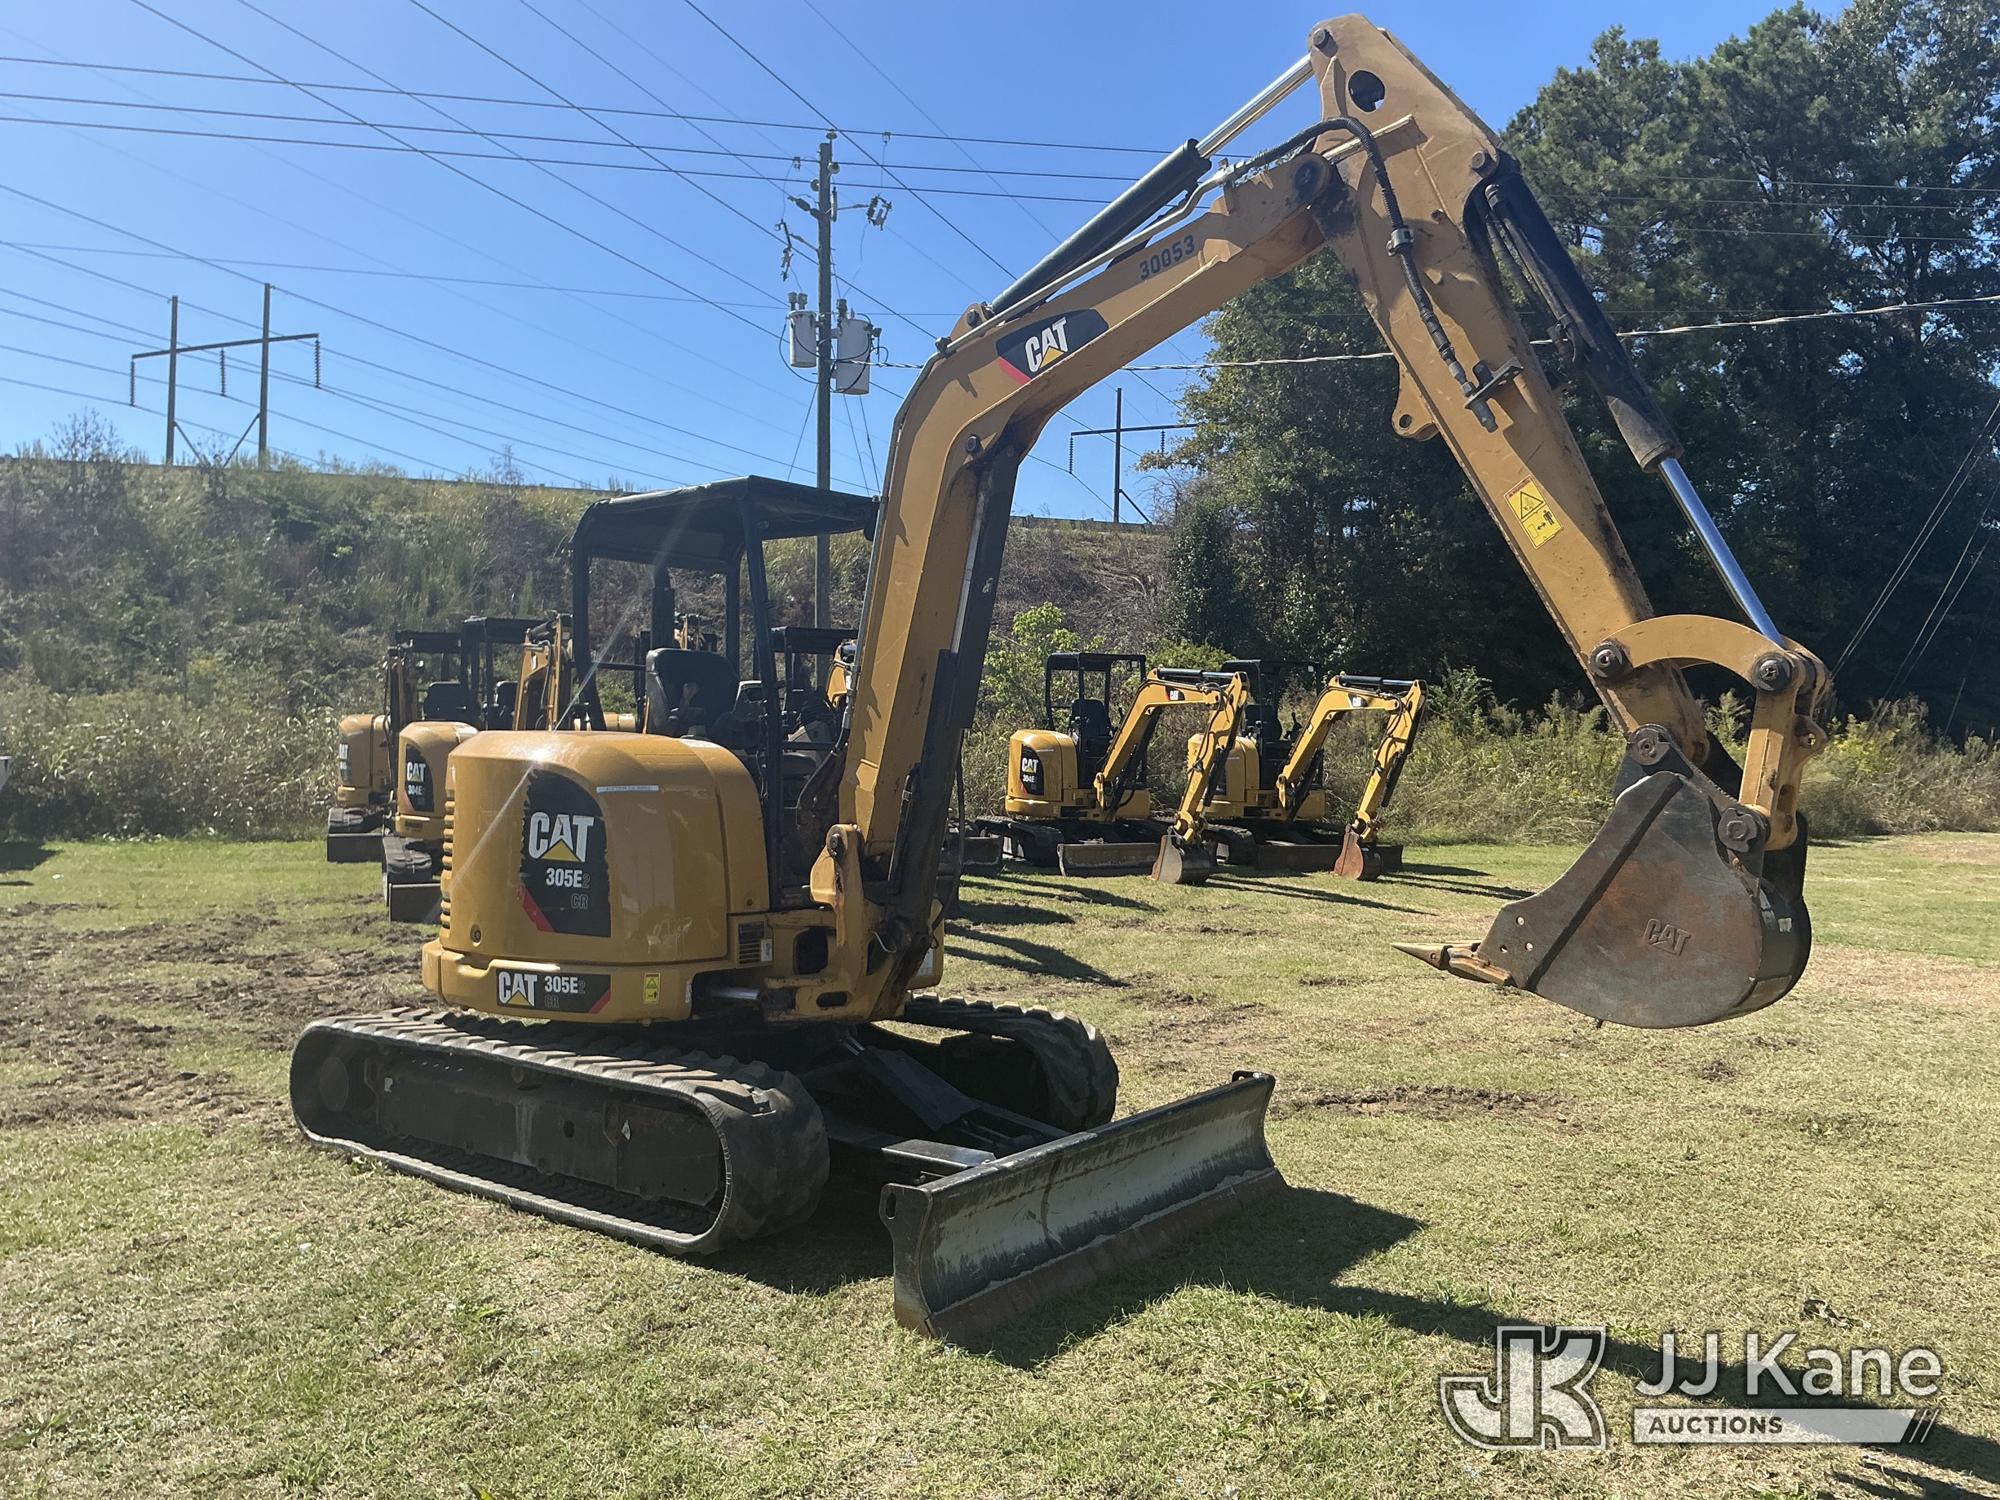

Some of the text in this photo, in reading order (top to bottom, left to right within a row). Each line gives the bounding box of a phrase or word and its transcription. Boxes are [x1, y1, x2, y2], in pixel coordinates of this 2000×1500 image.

[1138, 234, 1195, 280] 30053
[1024, 316, 1069, 373] CAT
[406, 761, 426, 783] CAT
[1021, 757, 1039, 773] CAT
[528, 811, 595, 862] CAT
[570, 893, 589, 910] CR
[1644, 918, 1692, 957] CAT
[498, 971, 538, 1007] CAT
